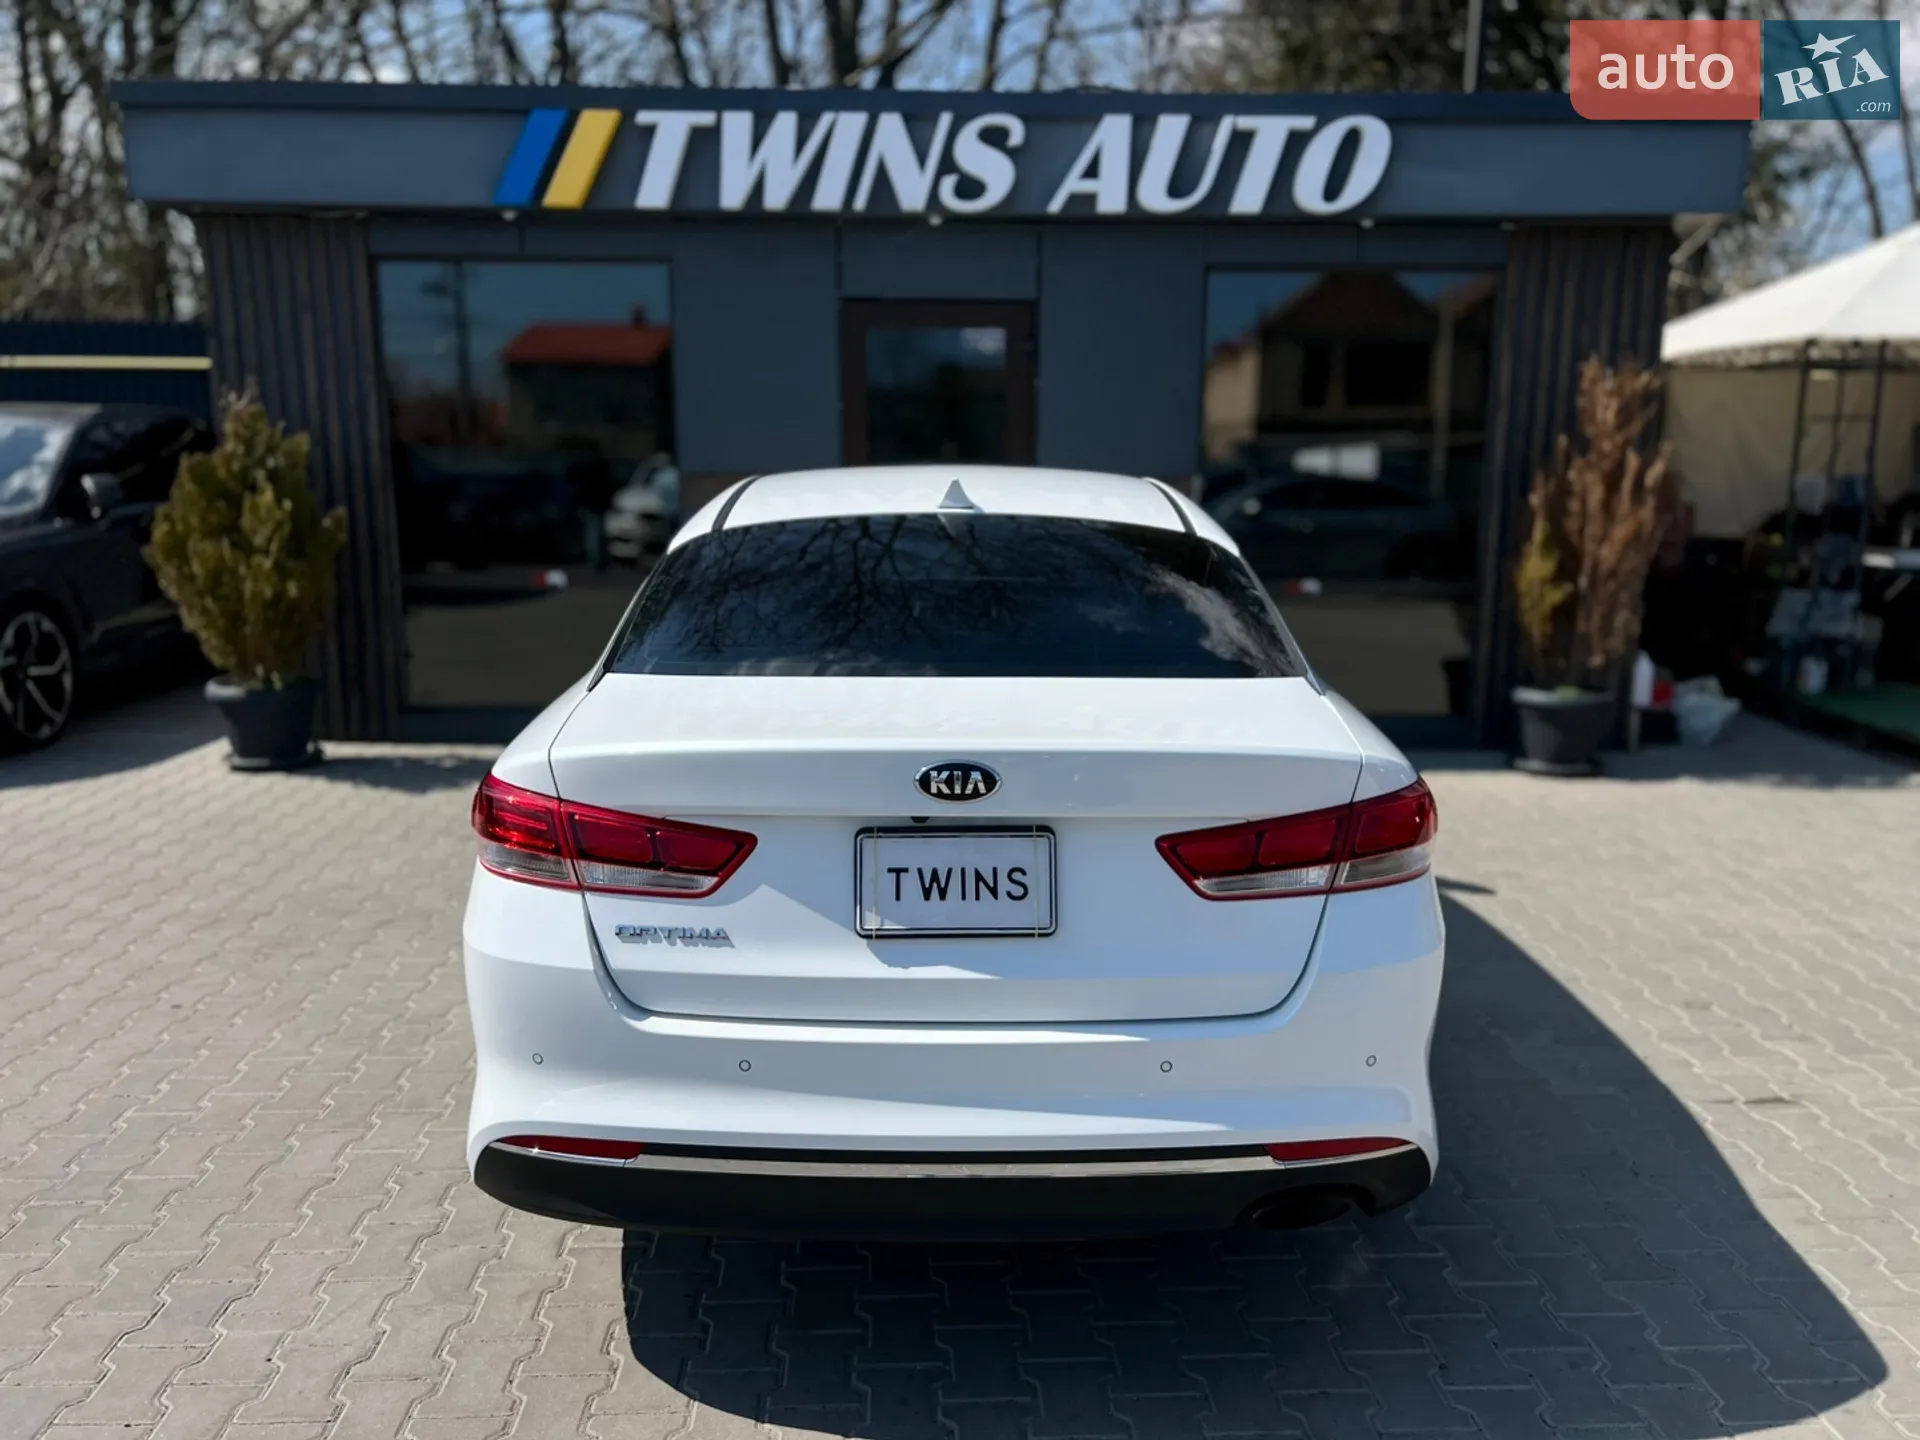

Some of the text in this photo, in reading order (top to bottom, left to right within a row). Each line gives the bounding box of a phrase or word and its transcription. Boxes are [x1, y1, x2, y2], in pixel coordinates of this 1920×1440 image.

[633, 108, 1394, 216] TWINS AUTO
[929, 770, 987, 795] KIA
[886, 866, 1029, 902] TWINS
